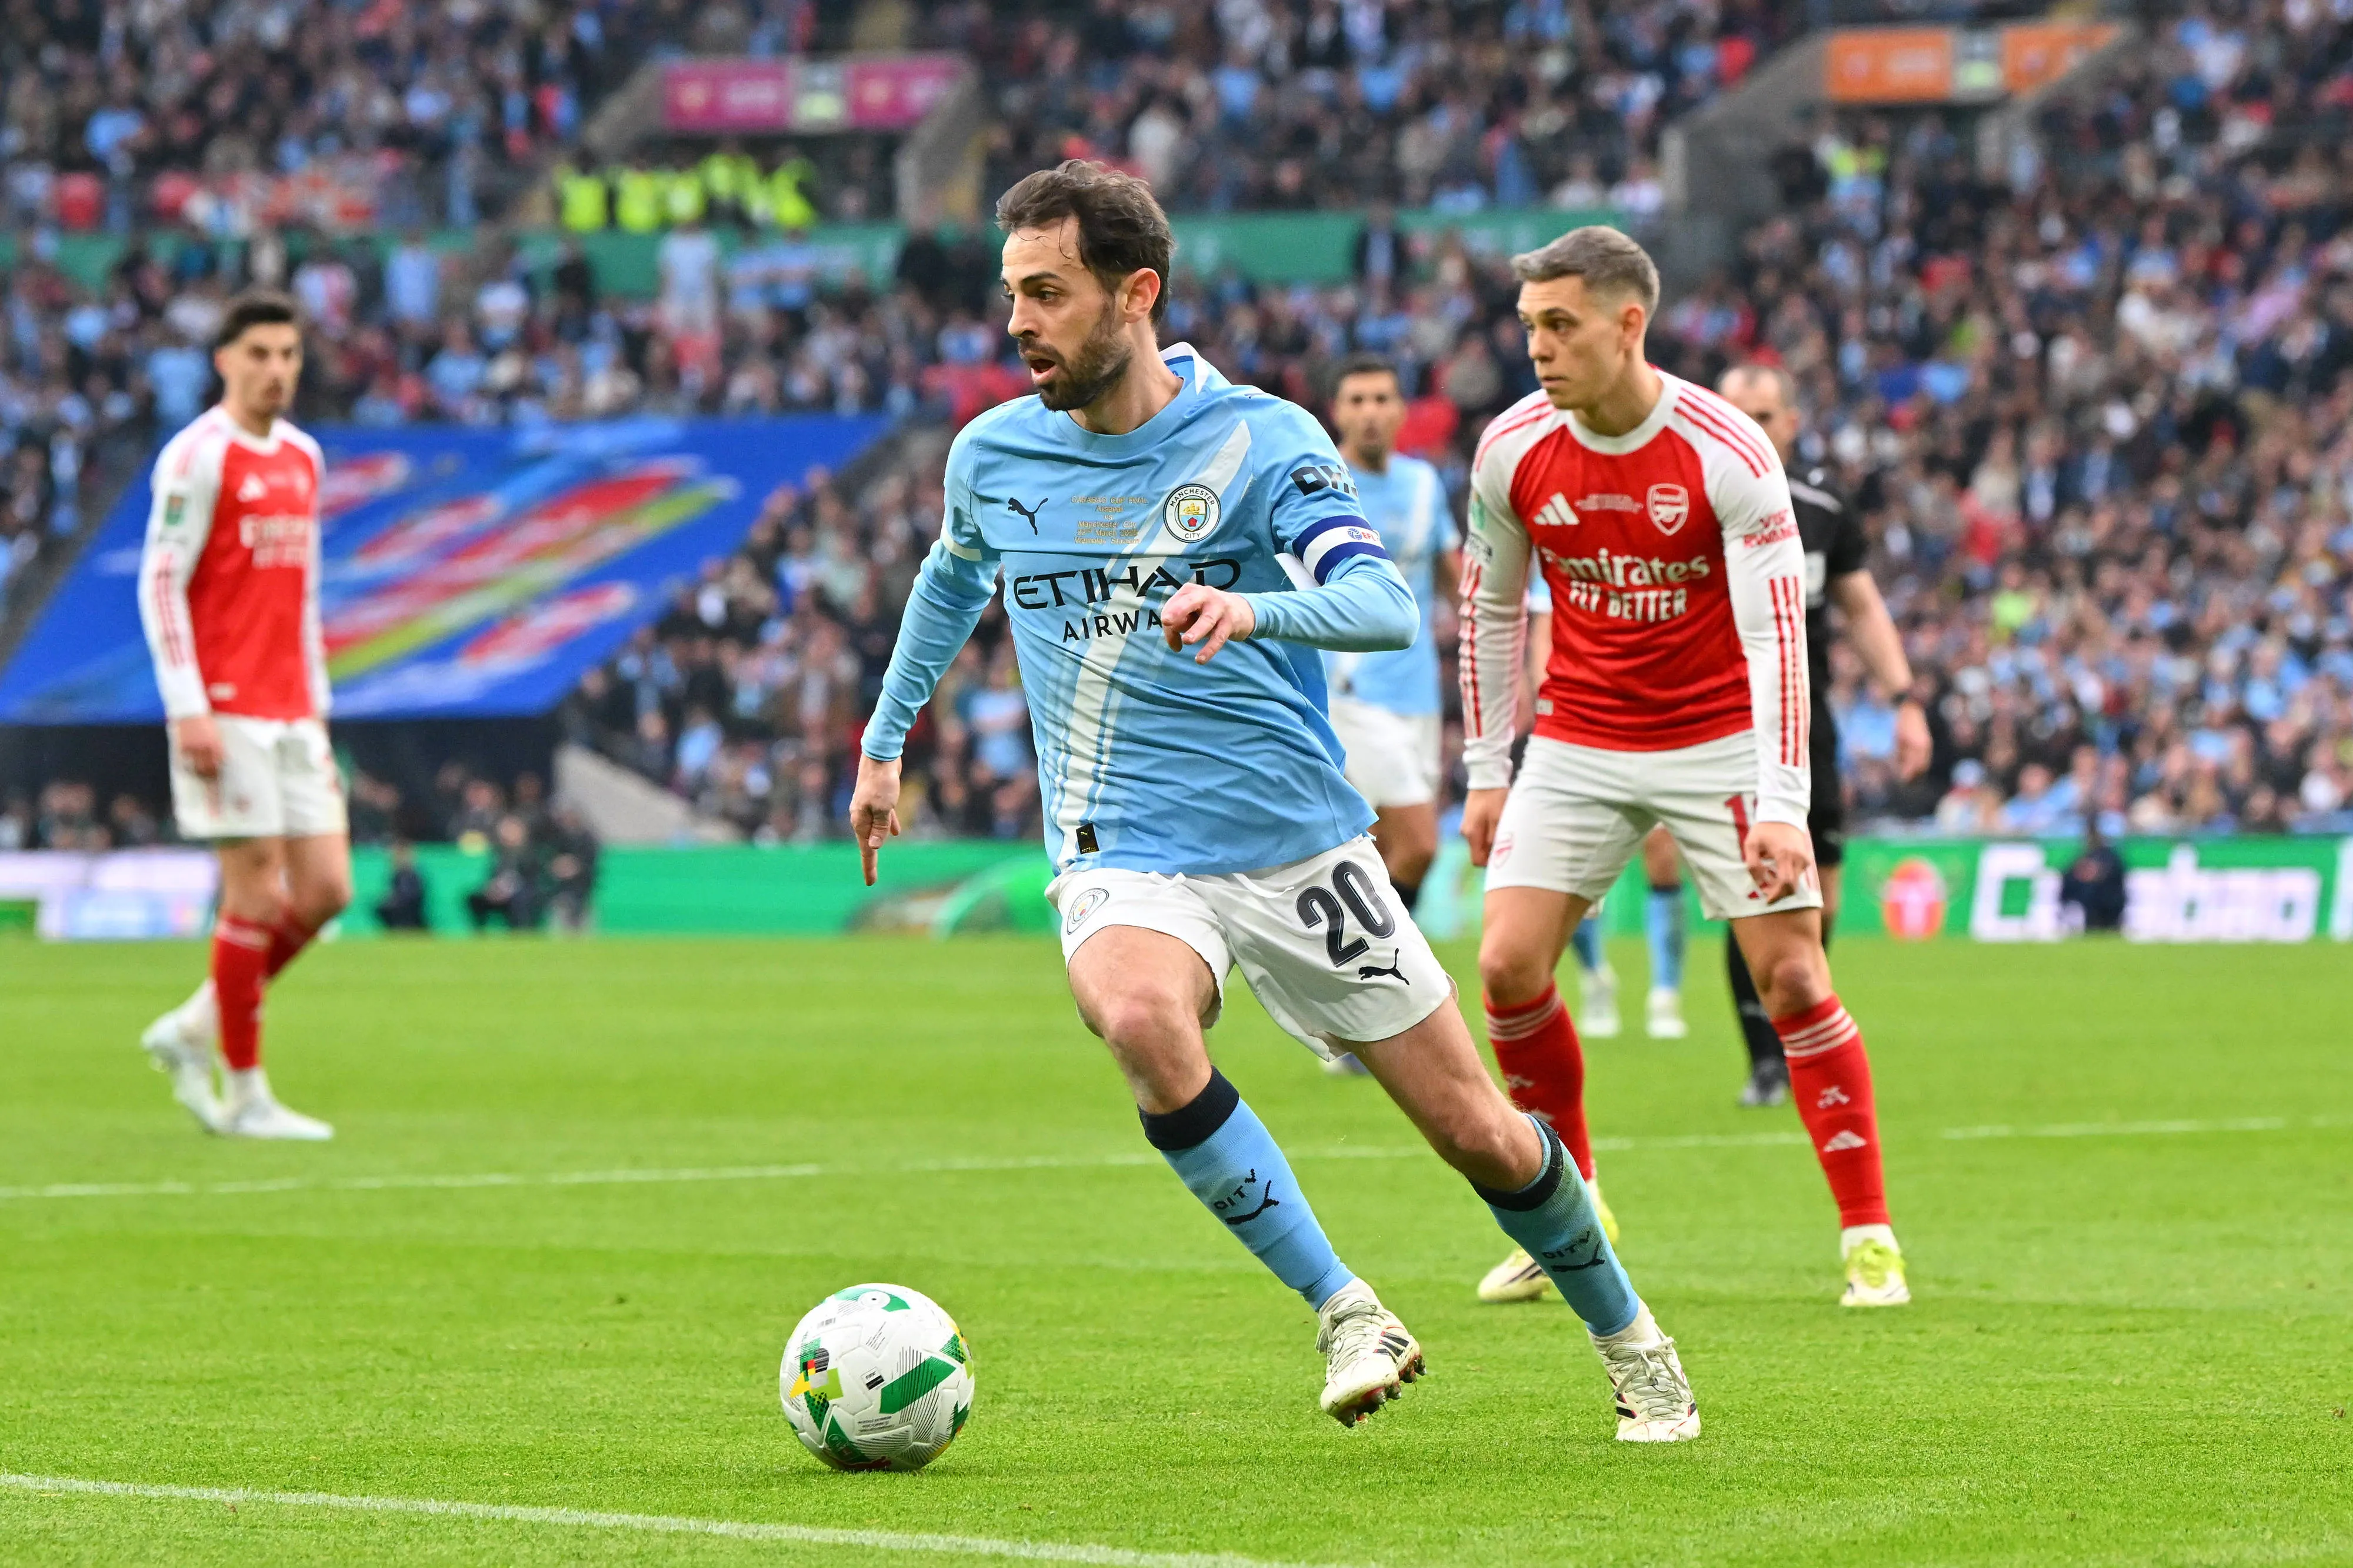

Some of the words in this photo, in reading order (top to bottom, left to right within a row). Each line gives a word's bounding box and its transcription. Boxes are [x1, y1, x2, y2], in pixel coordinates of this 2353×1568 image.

[1170, 489, 1215, 507] MANCHESTER
[1361, 532, 1377, 541] EFL
[1013, 558, 1241, 610] ETIHAD
[1062, 610, 1163, 643] AIRWA
[1724, 795, 1758, 863] 1
[1295, 860, 1395, 968] 20
